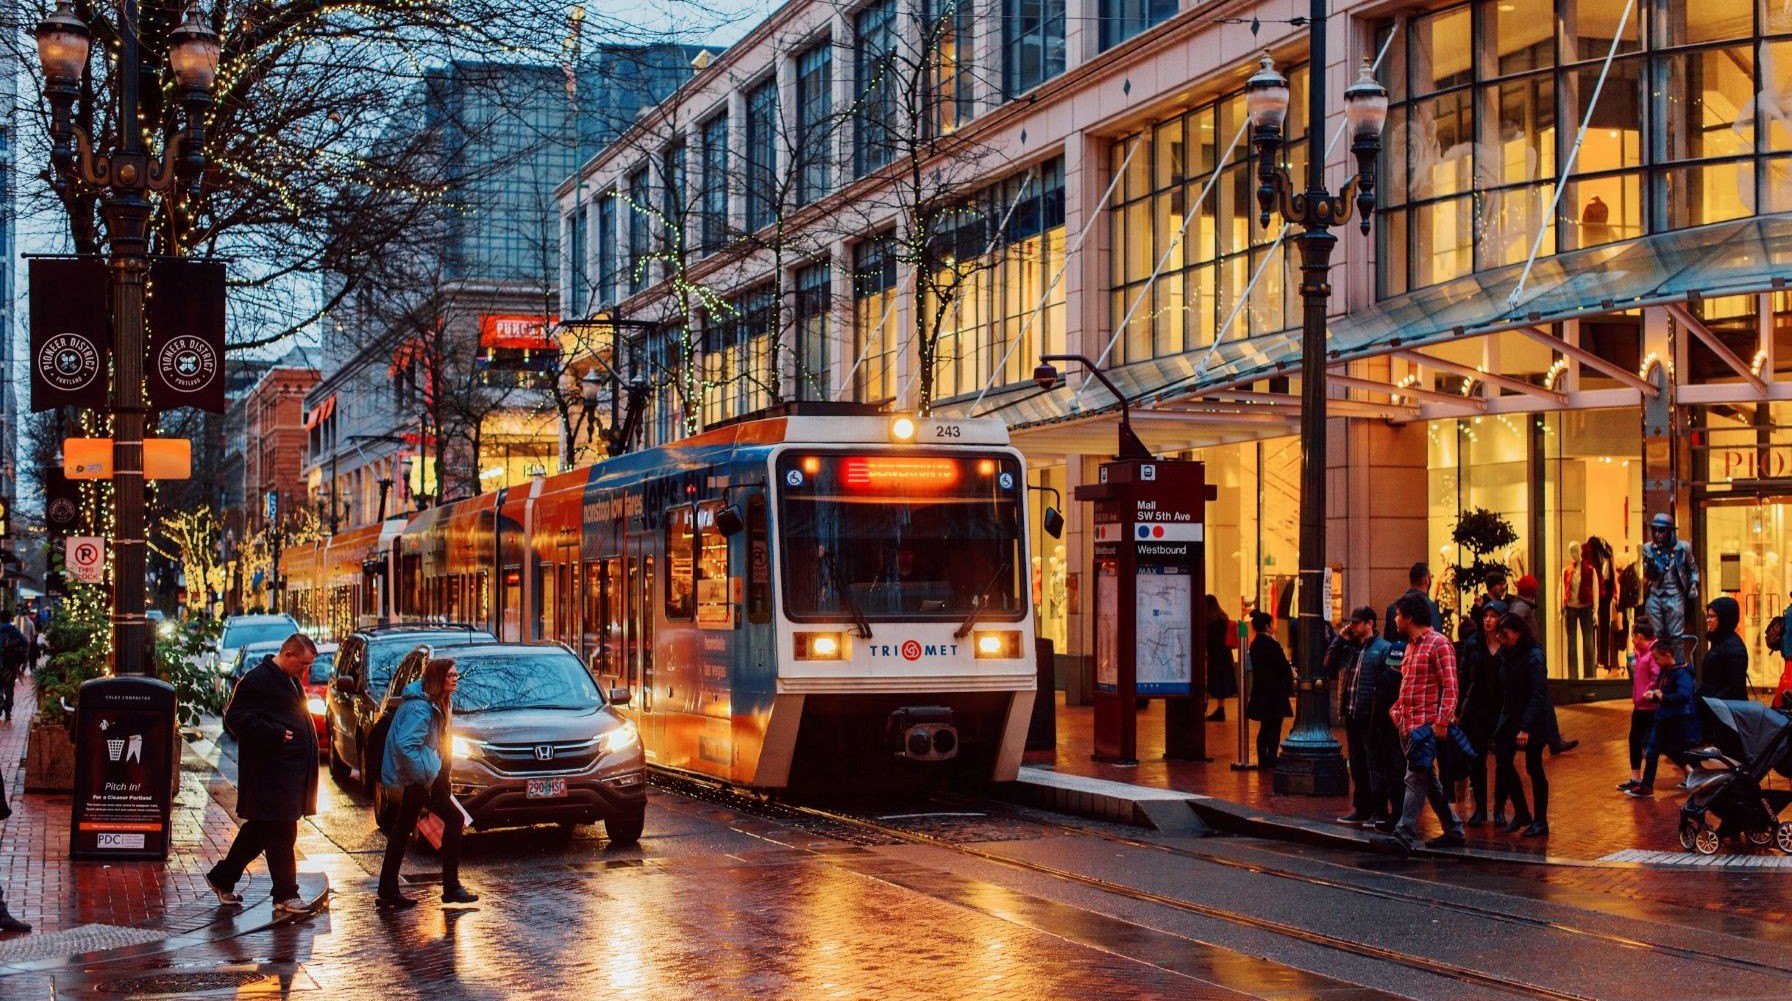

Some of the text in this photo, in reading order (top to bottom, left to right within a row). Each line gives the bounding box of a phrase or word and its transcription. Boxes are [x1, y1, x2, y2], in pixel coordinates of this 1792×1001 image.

[43, 337, 95, 371] PIONEER DISTRICT
[162, 339, 213, 373] PIONEER DISTRICT
[56, 376, 82, 385] PORTLAND
[175, 378, 201, 386] PORTLAND
[936, 426, 961, 438] 243
[583, 498, 611, 524] nonstop
[611, 493, 624, 519] low
[624, 489, 643, 518] fares
[1137, 500, 1156, 510] Mall
[1137, 511, 1191, 521] SW 5th Ave
[1137, 545, 1187, 555] Westbound
[78, 566, 94, 574] THIS
[870, 644, 958, 657] TRI MET
[104, 782, 141, 791] Pitch In!
[529, 782, 544, 794] 290
[98, 834, 121, 845] PDC
